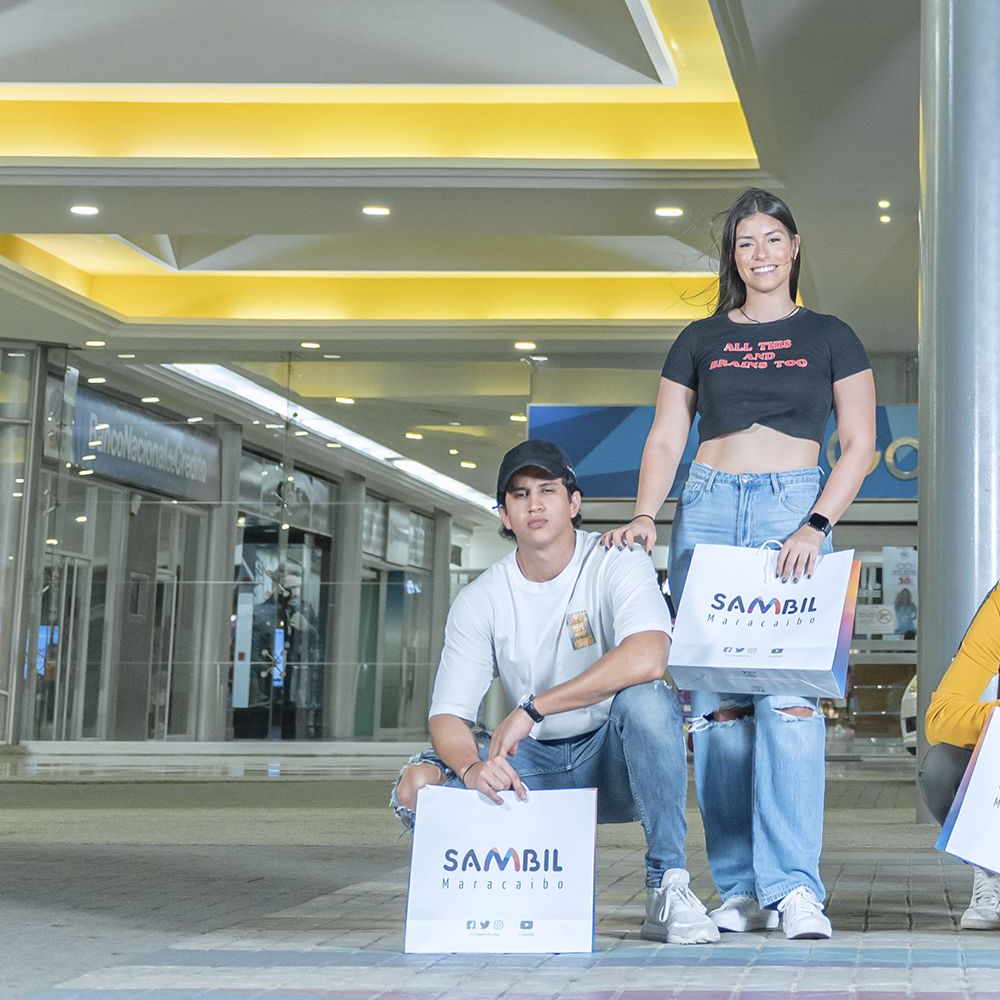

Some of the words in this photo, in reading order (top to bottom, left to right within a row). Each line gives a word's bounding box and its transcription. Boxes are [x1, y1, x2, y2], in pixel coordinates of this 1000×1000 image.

[723, 342, 753, 352] ALL
[757, 339, 792, 351] THIS
[742, 352, 776, 360] AND
[709, 359, 768, 370] BRAINS
[774, 358, 808, 368] TOO
[711, 593, 817, 615] SAMBIL
[707, 613, 816, 627] Maracaibo
[443, 847, 563, 872] SAMBIL
[442, 877, 564, 890] Maracaibo
